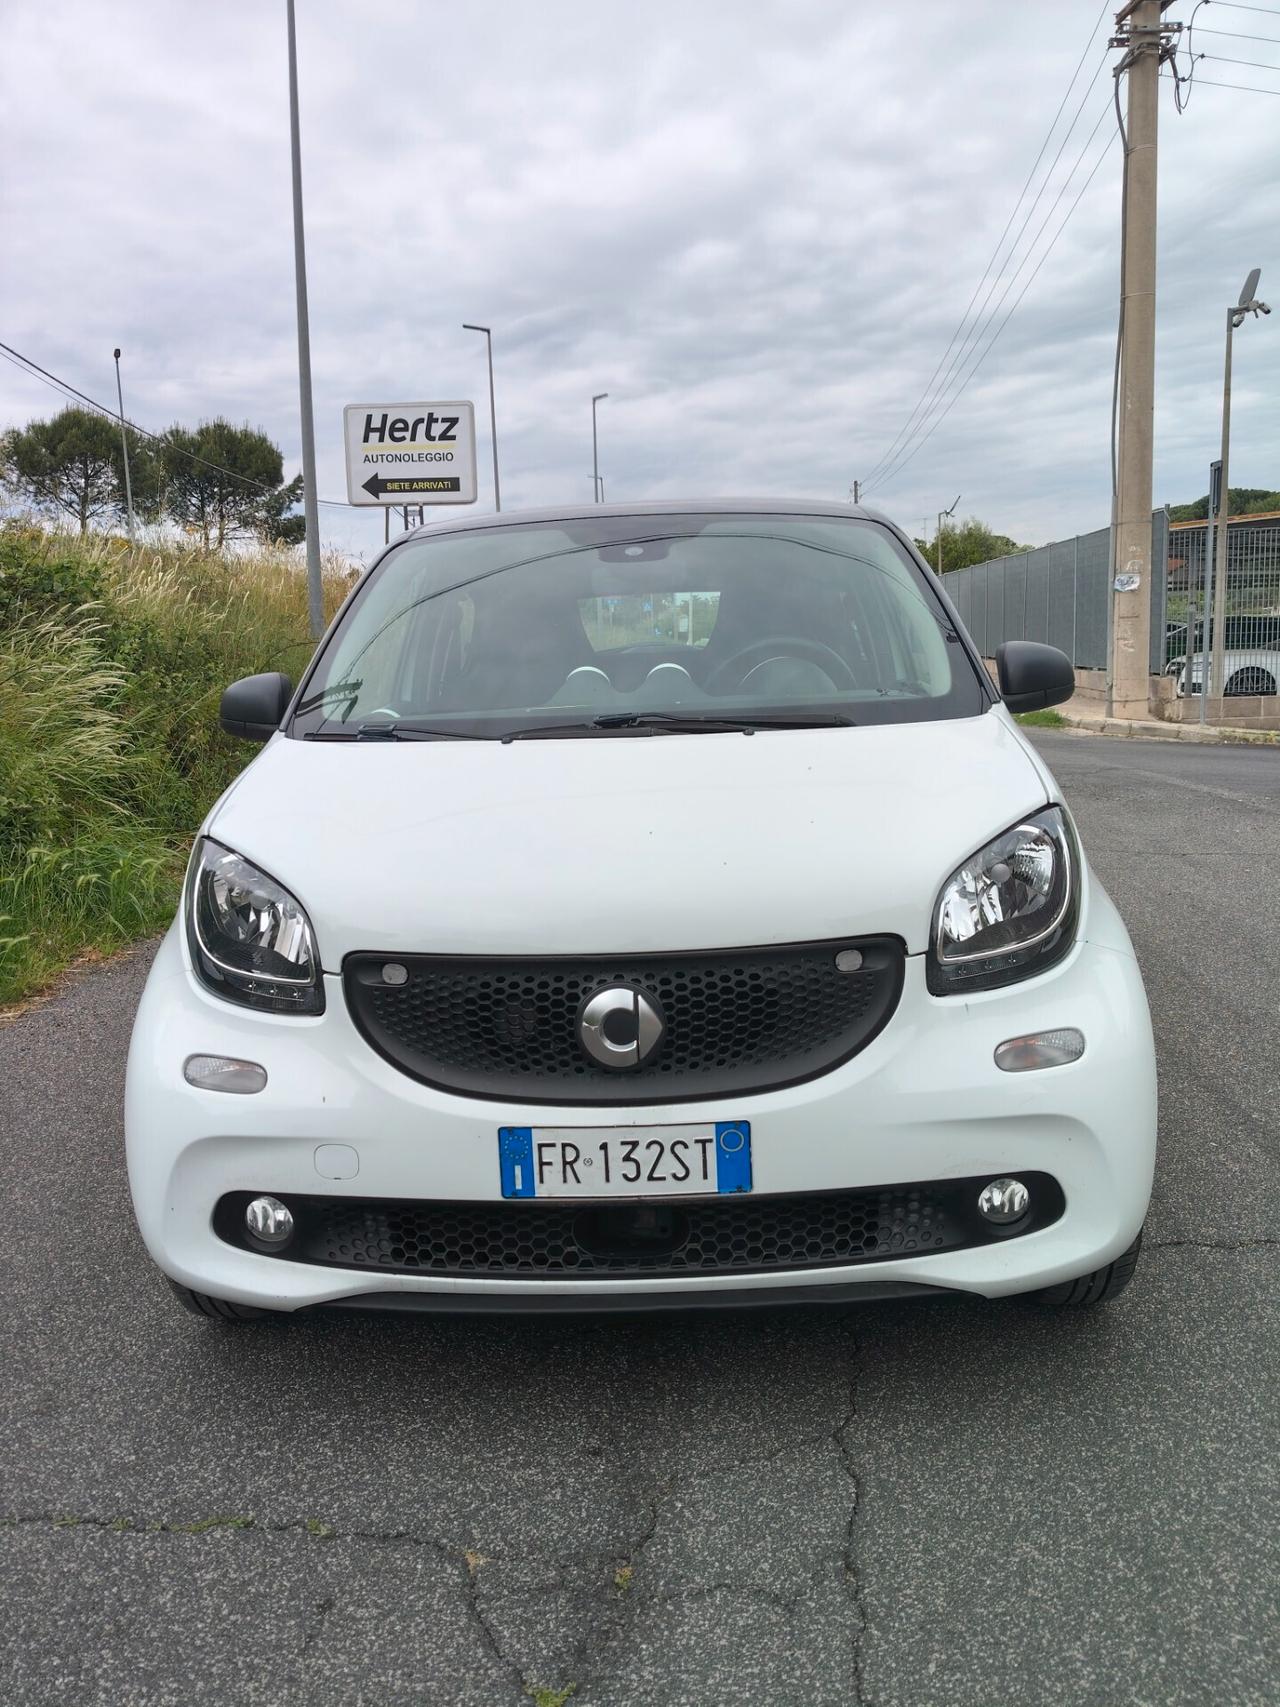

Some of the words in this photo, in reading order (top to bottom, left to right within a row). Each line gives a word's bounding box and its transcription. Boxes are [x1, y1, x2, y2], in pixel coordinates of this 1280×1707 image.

[362, 412, 459, 443] Hertz
[363, 452, 454, 463] AUTONOLEGGIO
[386, 482, 411, 490] SIETE
[412, 481, 451, 489] ARRIVATI
